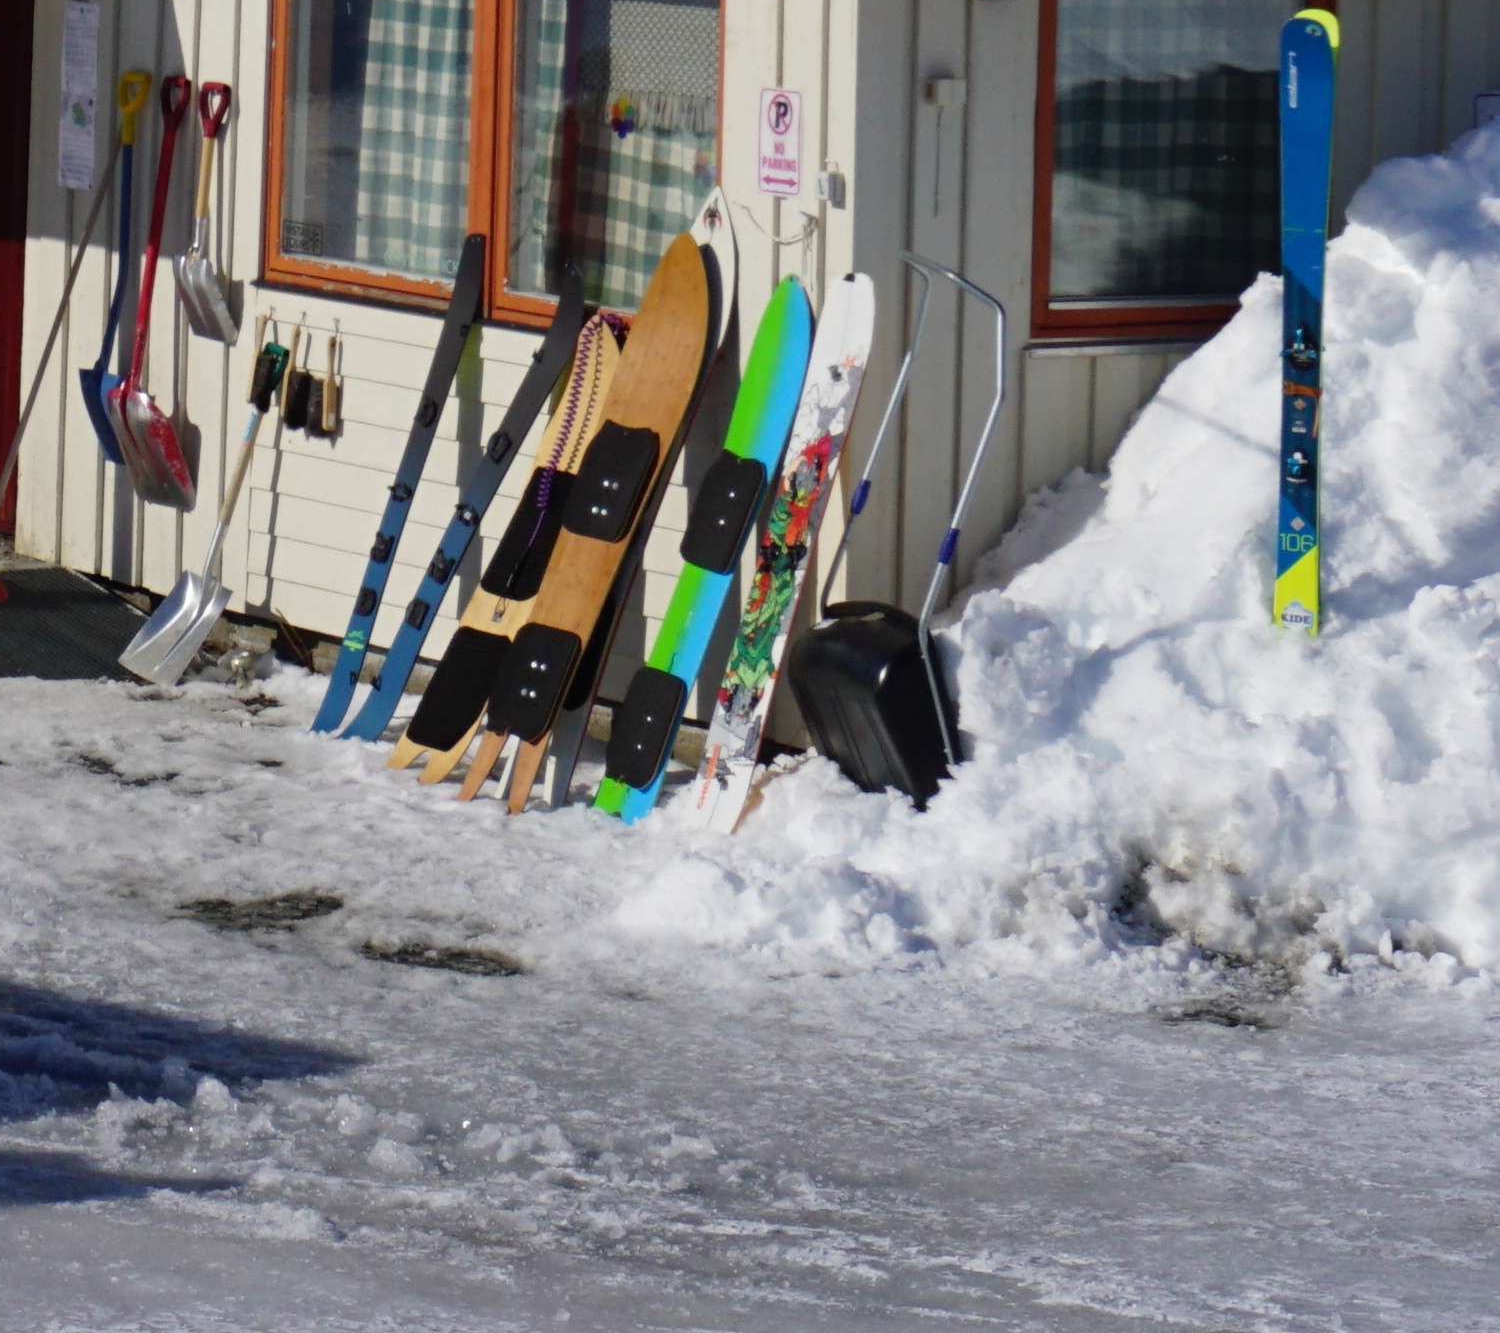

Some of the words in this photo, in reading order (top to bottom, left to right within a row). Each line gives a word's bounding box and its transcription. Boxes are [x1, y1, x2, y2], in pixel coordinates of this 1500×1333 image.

[773, 141, 785, 155] NO
[761, 156, 797, 173] PARKING
[1279, 532, 1314, 553] 106
[1281, 612, 1311, 625] KIDE
